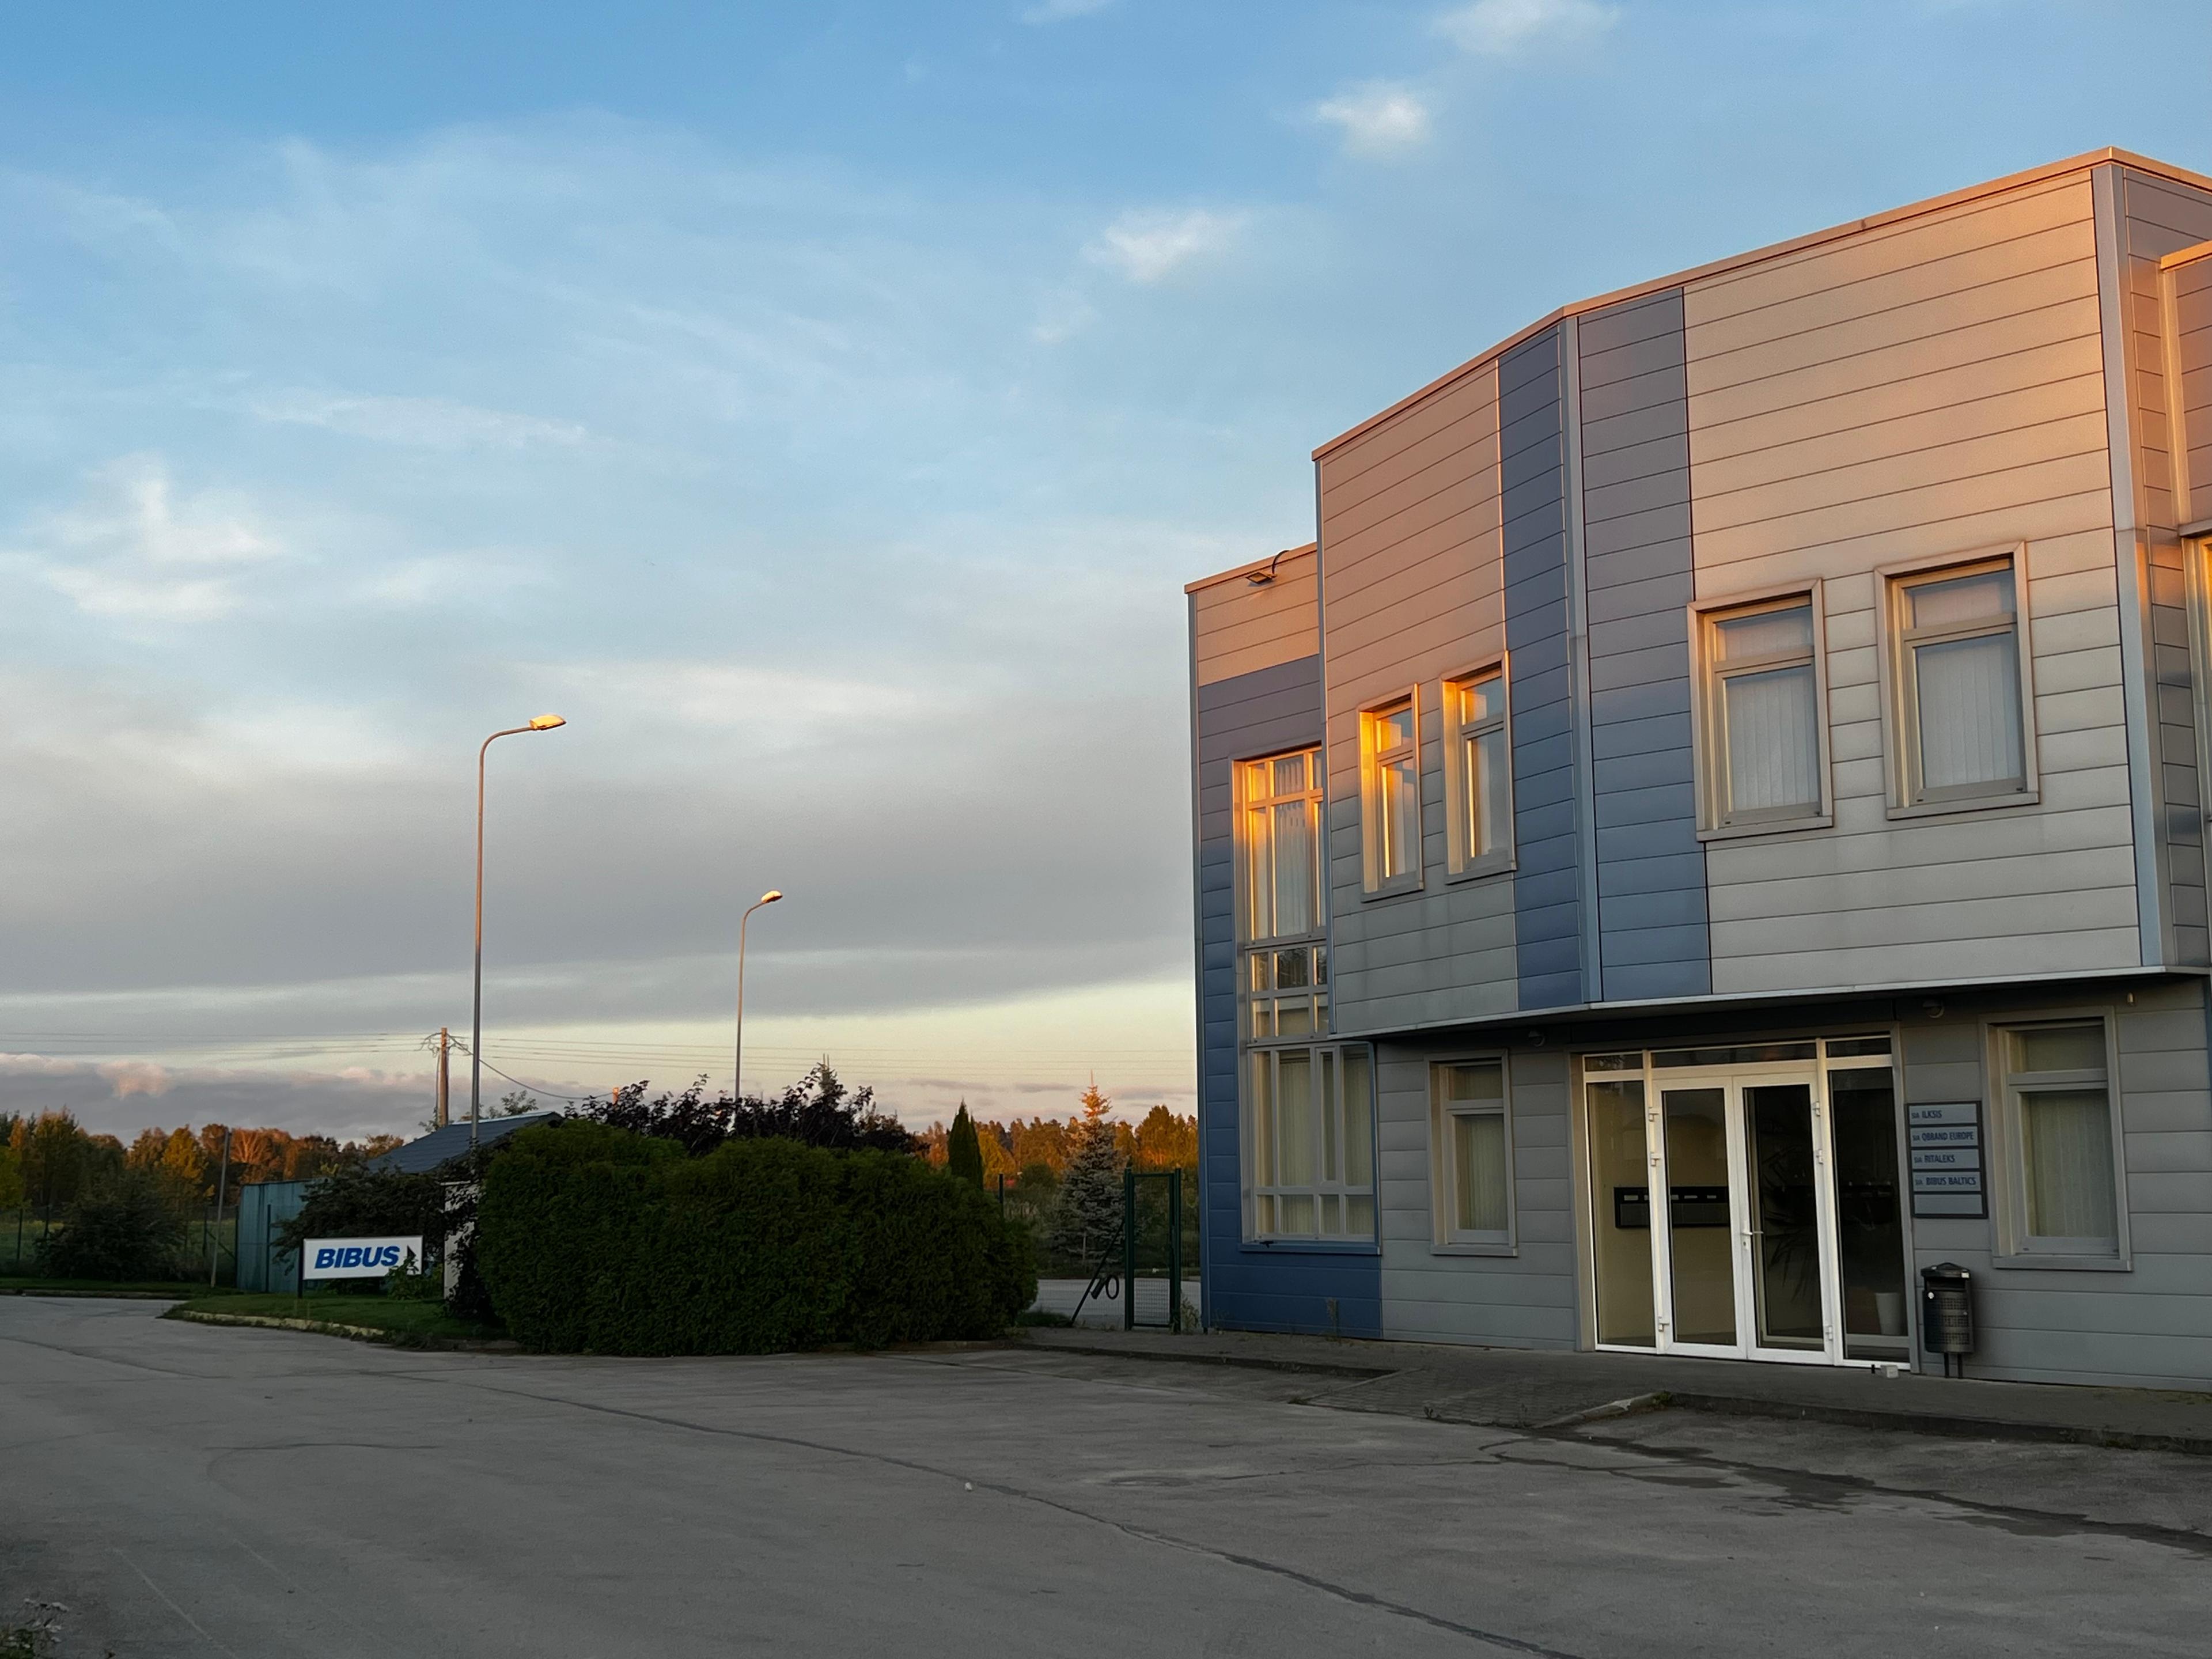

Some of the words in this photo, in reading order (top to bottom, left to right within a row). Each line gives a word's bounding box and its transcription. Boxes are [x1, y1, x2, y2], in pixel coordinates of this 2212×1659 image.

[1949, 1131, 1974, 1141] EUROPE
[1926, 1177, 1947, 1185] BIBUS
[1948, 1176, 1976, 1185] BALTICS
[315, 1246, 400, 1269] BIBUS
